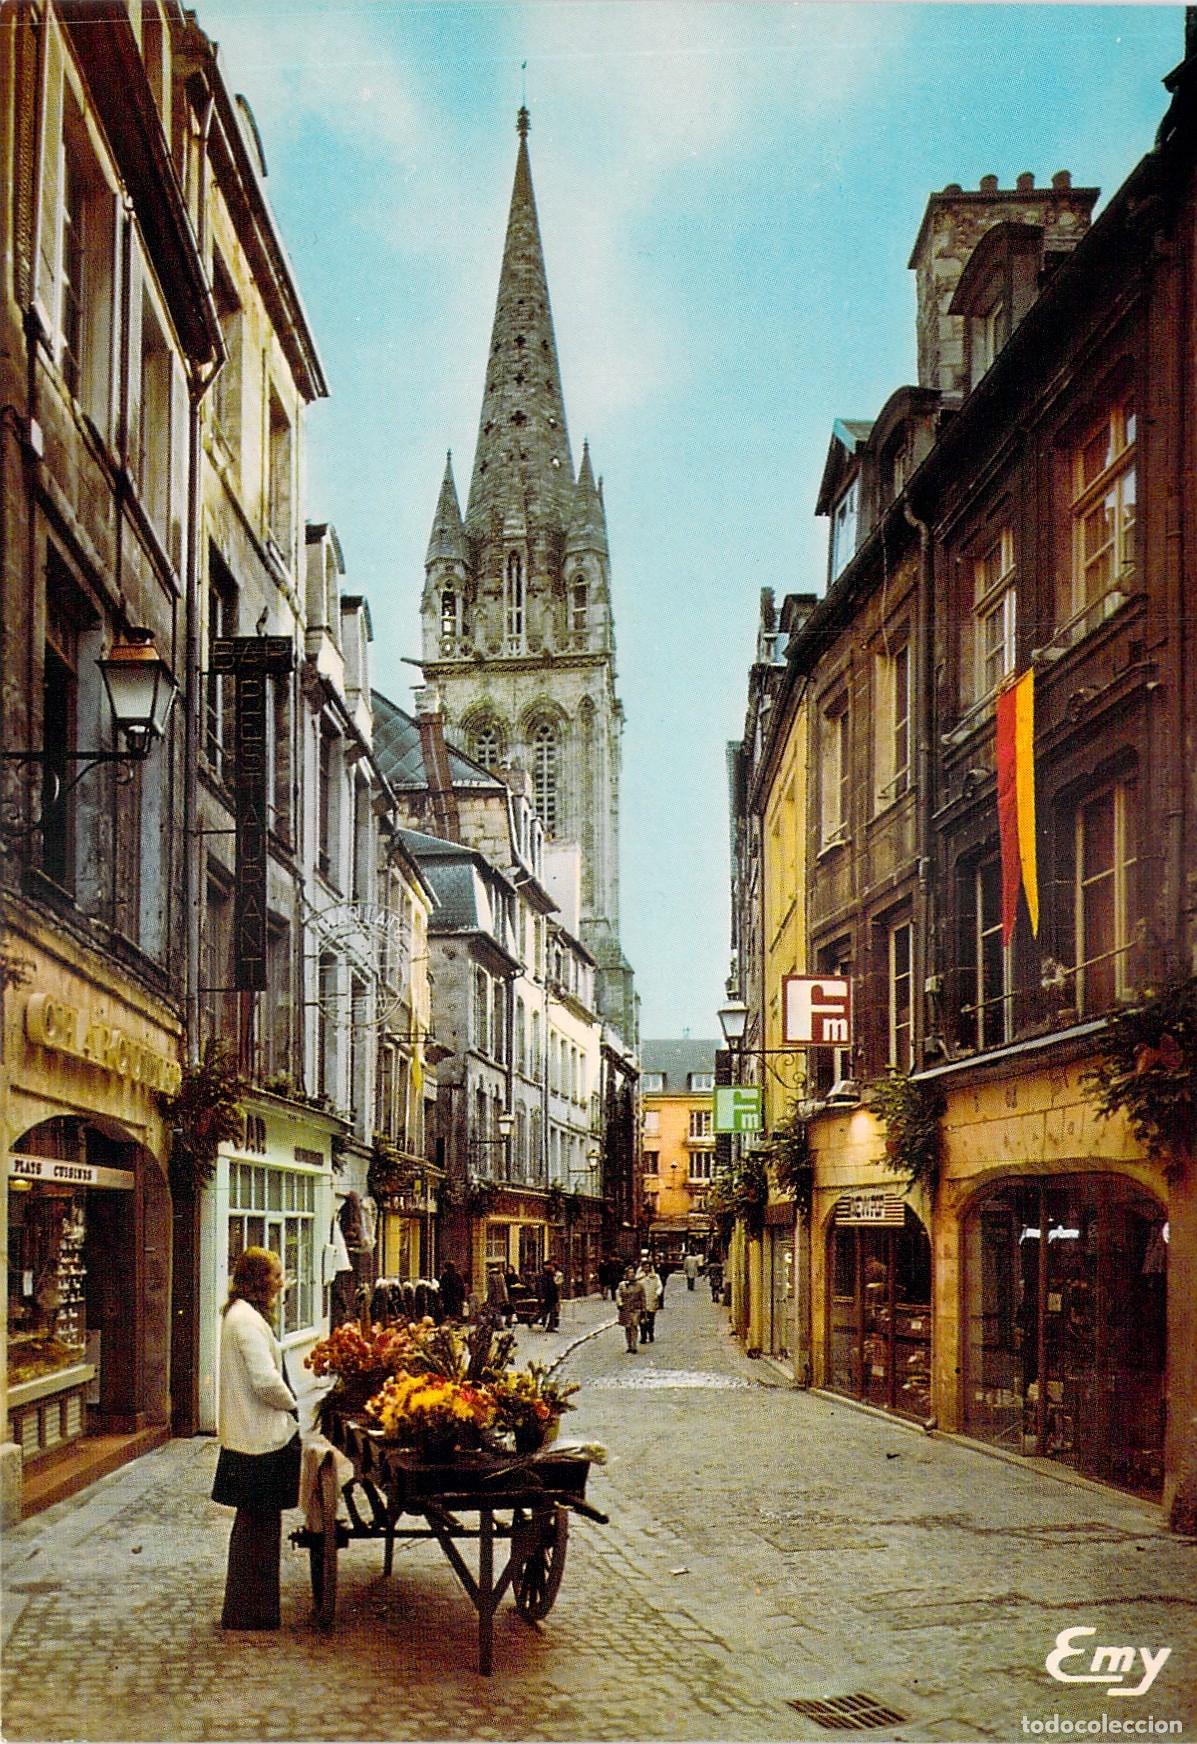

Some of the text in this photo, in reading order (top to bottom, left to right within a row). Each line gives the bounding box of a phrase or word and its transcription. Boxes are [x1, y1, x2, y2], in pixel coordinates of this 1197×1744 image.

[238, 679, 263, 985] RESTAURANT
[27, 992, 183, 1098] CHARCU
[13, 1158, 93, 1182] PLATS CUISINES
